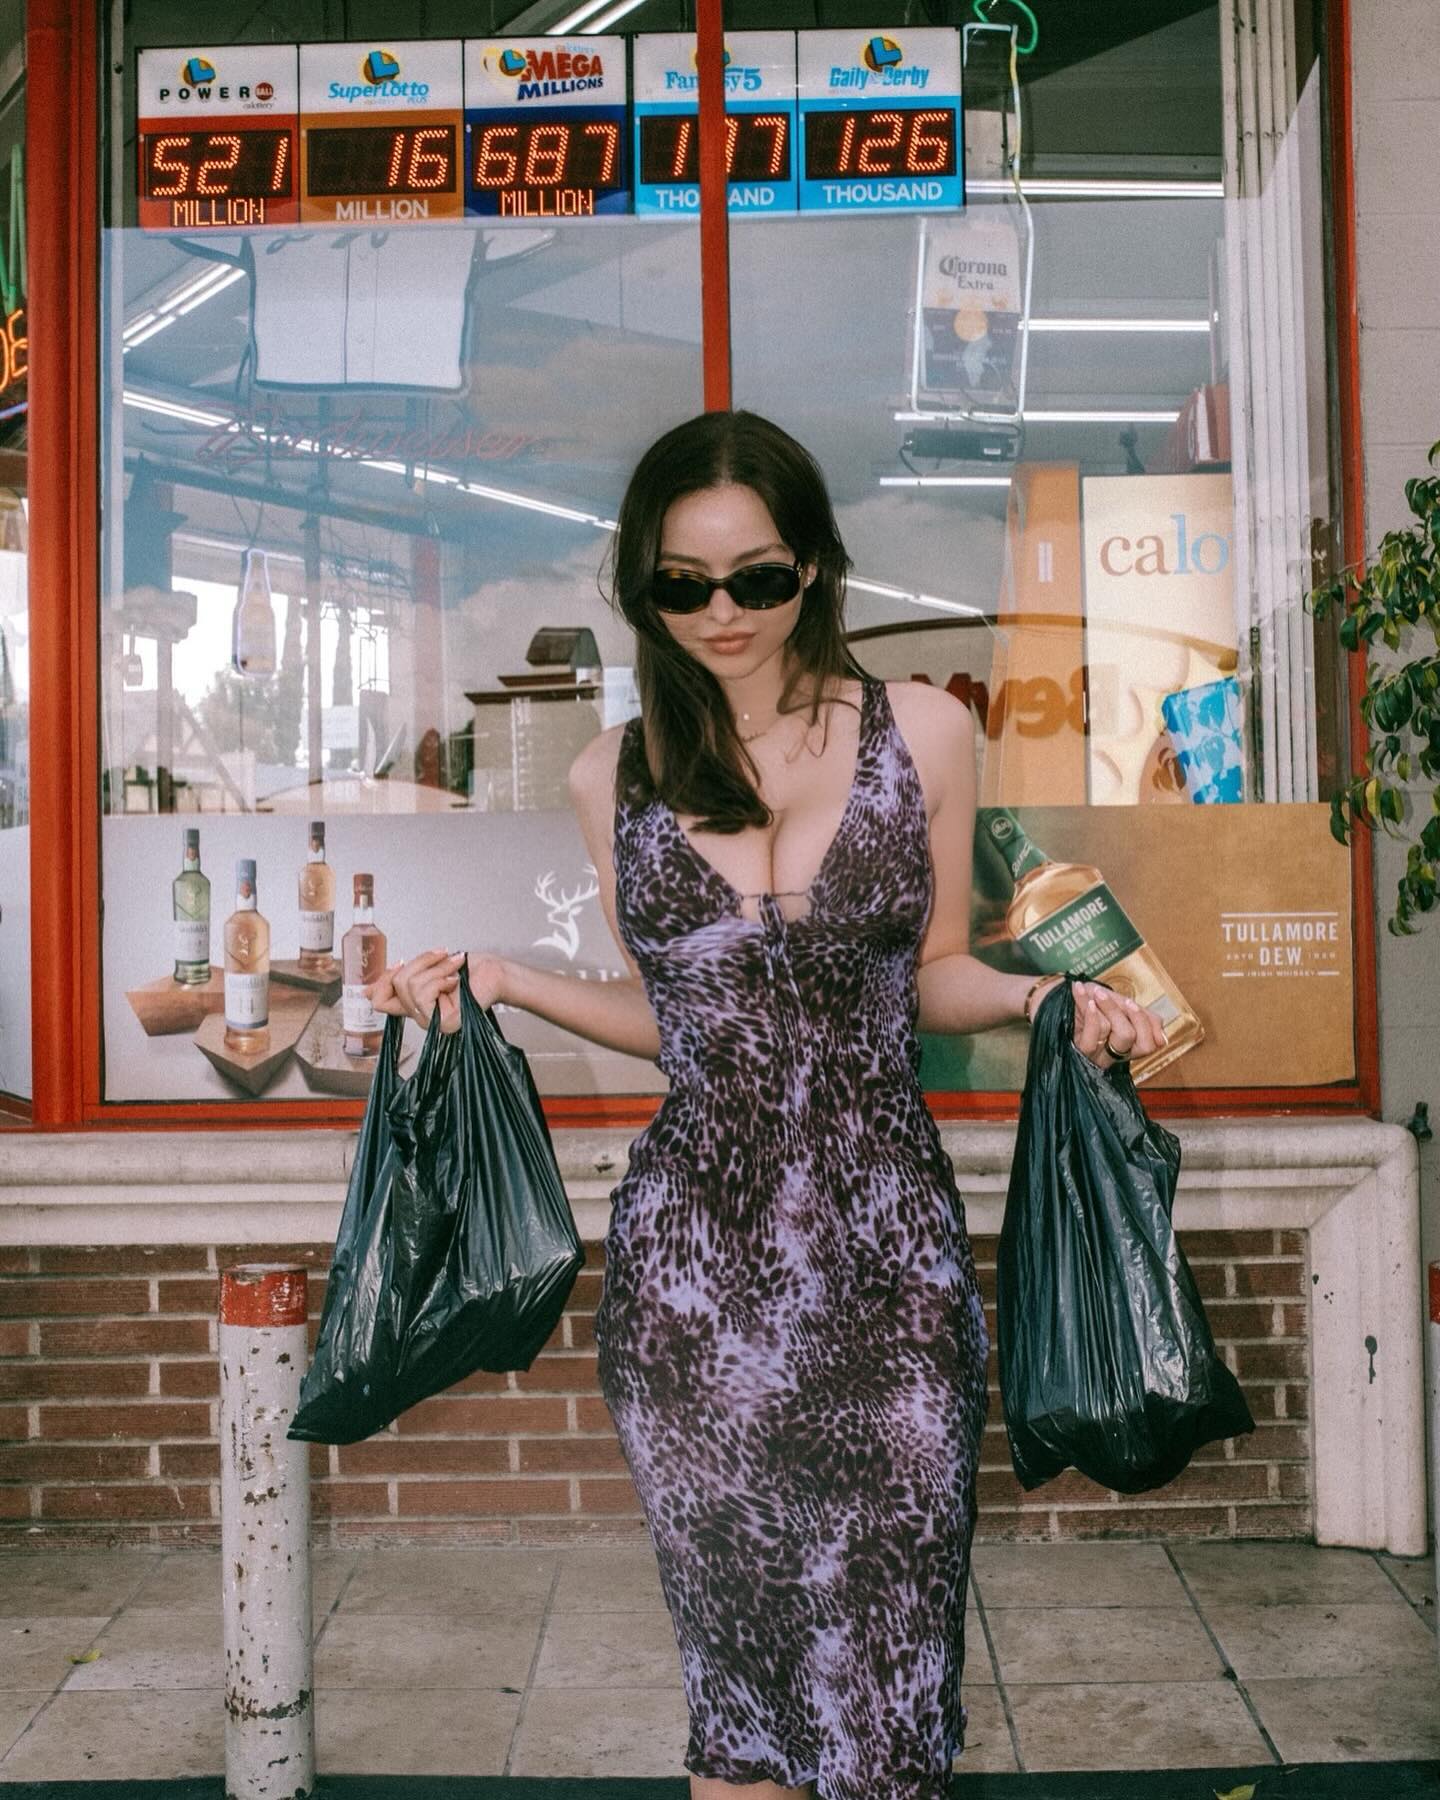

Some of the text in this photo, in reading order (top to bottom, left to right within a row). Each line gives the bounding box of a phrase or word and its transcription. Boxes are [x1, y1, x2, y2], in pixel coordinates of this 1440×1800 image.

[520, 49, 604, 81] MEGA
[327, 80, 430, 103] SuperLotto
[517, 77, 604, 101] MILLIONS
[665, 67, 762, 92] Fany 5
[476, 125, 618, 186] 687
[838, 113, 949, 173] 126
[153, 136, 289, 196] 521
[388, 129, 449, 188] 16
[502, 189, 593, 217] MILLION
[655, 187, 775, 209] THOAND
[822, 182, 943, 203] THOUSAND
[174, 198, 265, 226] MILLION
[336, 200, 429, 221] MILLION
[939, 255, 1008, 279] Corona
[957, 276, 994, 291] Extra
[1100, 511, 1233, 577] calo
[1029, 897, 1108, 953] TULLAMORE
[1221, 922, 1339, 942] TULLAMORE
